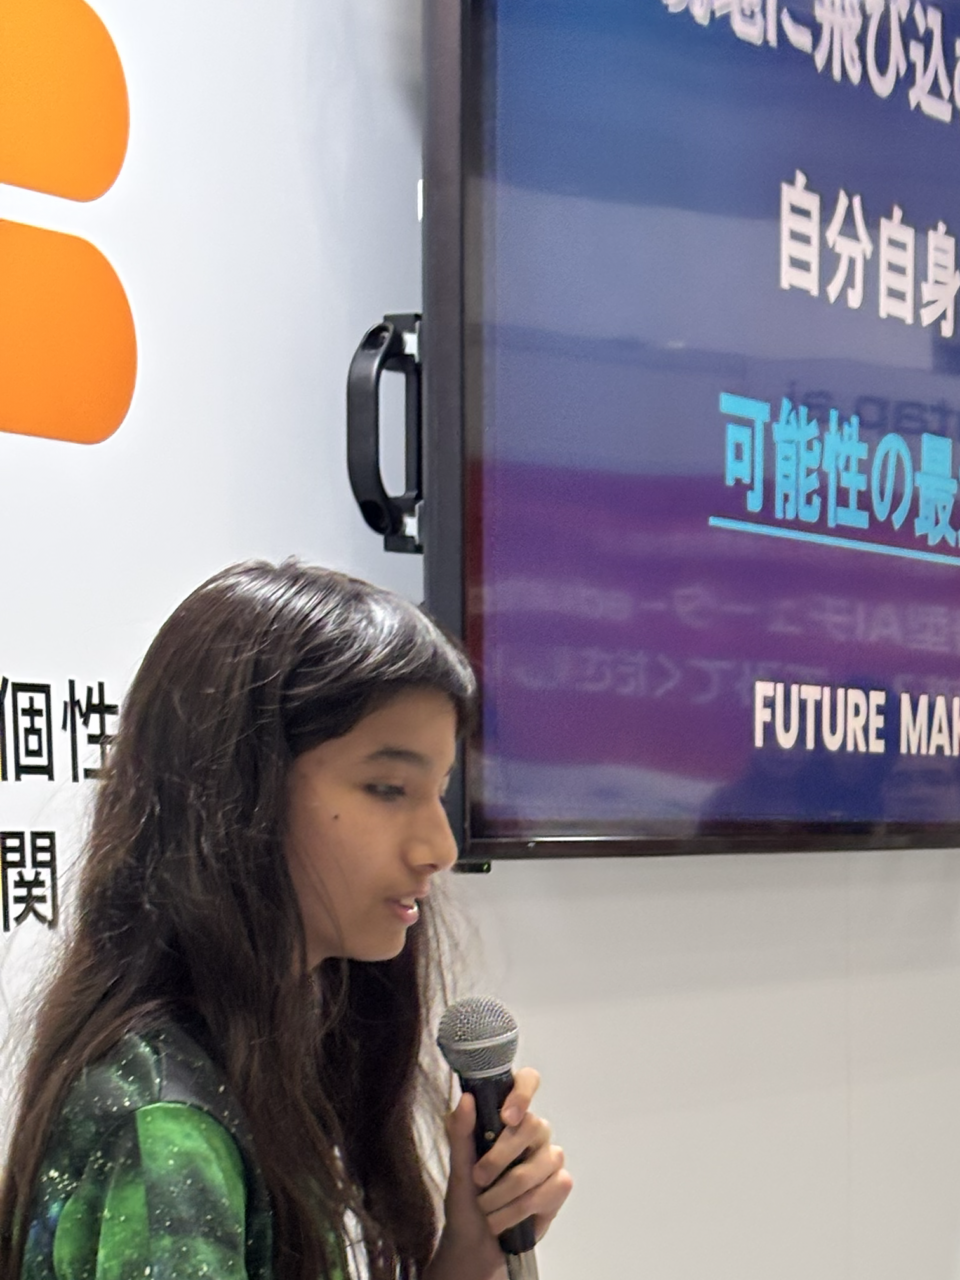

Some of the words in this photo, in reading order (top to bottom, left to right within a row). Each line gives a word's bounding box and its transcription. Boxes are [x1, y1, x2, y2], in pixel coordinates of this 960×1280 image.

[0, 676, 119, 782] 個性
[753, 680, 886, 755] FUTURE
[0, 830, 58, 933] 関
